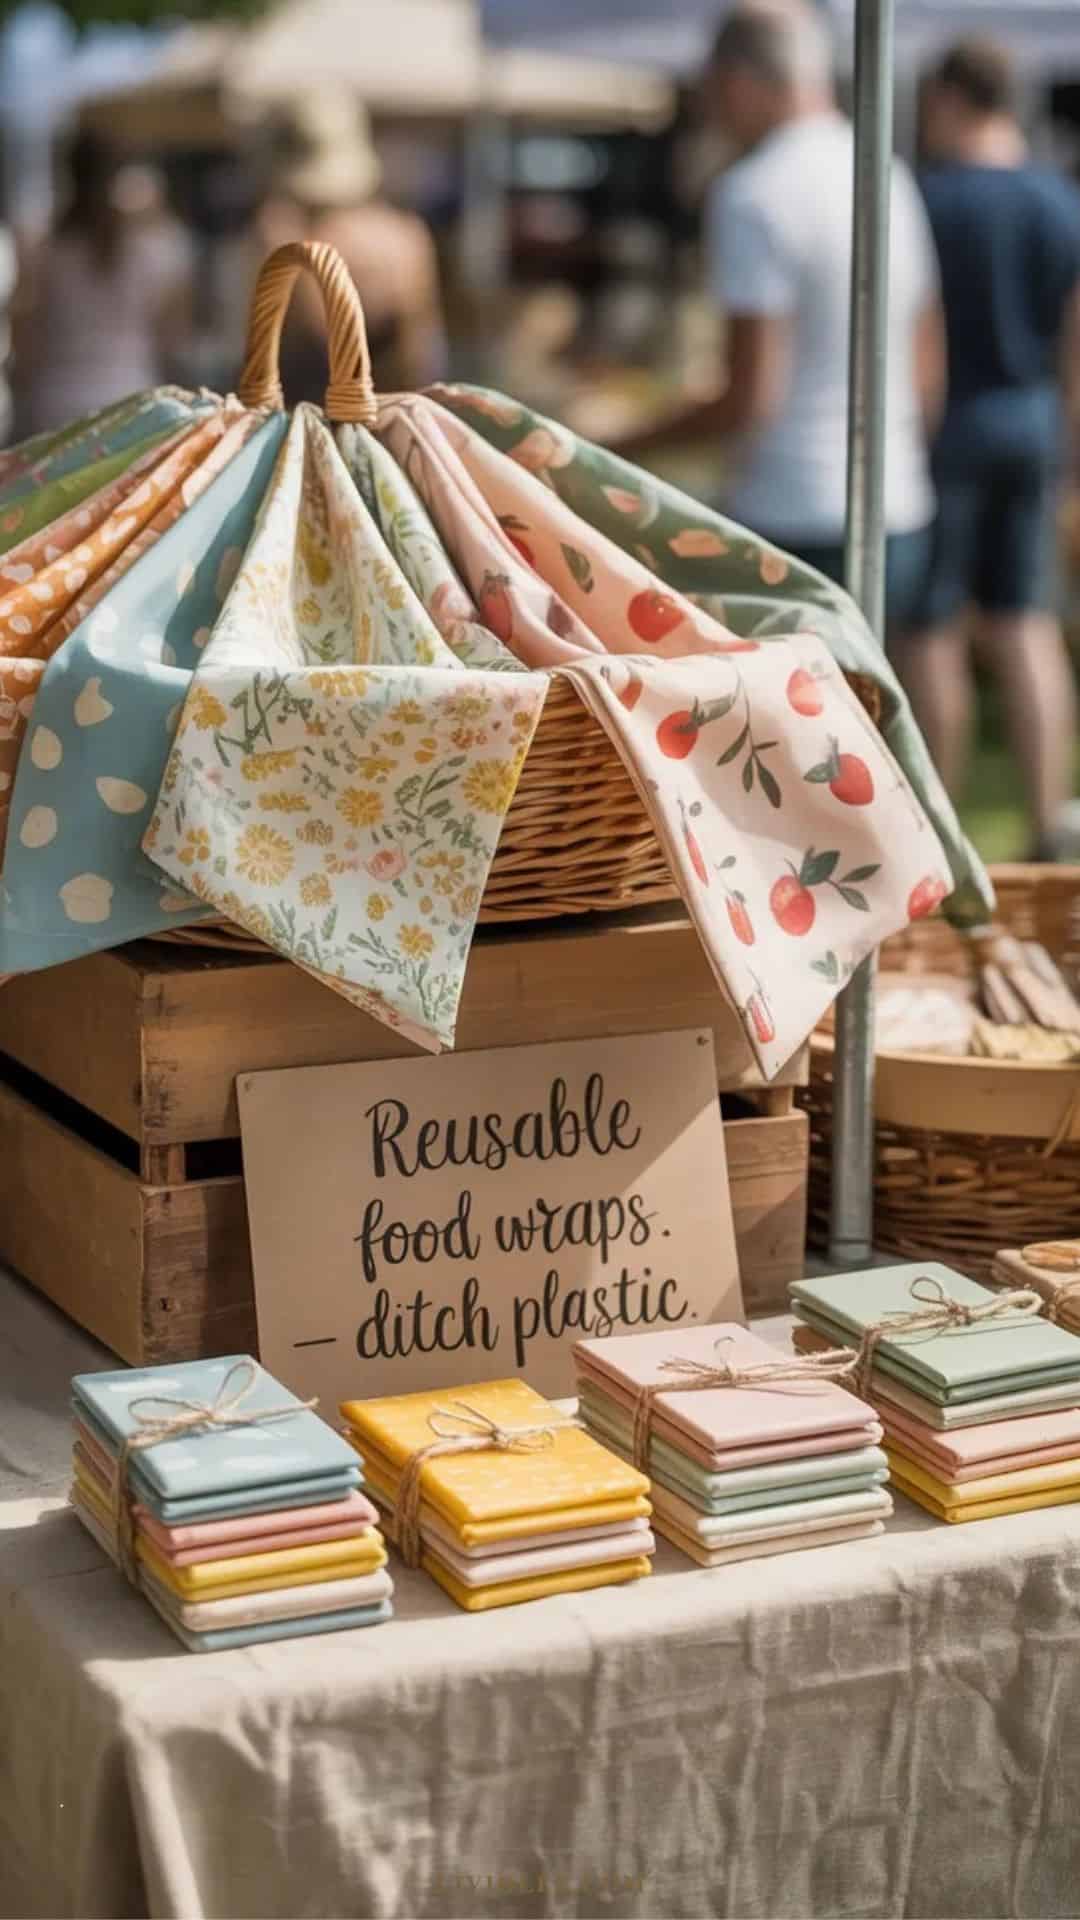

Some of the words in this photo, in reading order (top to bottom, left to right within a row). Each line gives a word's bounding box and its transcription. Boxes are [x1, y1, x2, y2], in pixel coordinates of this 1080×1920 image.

[363, 1073, 642, 1178] Reusable
[354, 1190, 481, 1283] food
[495, 1194, 672, 1264] wraps.
[356, 1277, 499, 1360] ditch
[513, 1267, 699, 1369] plastic.
